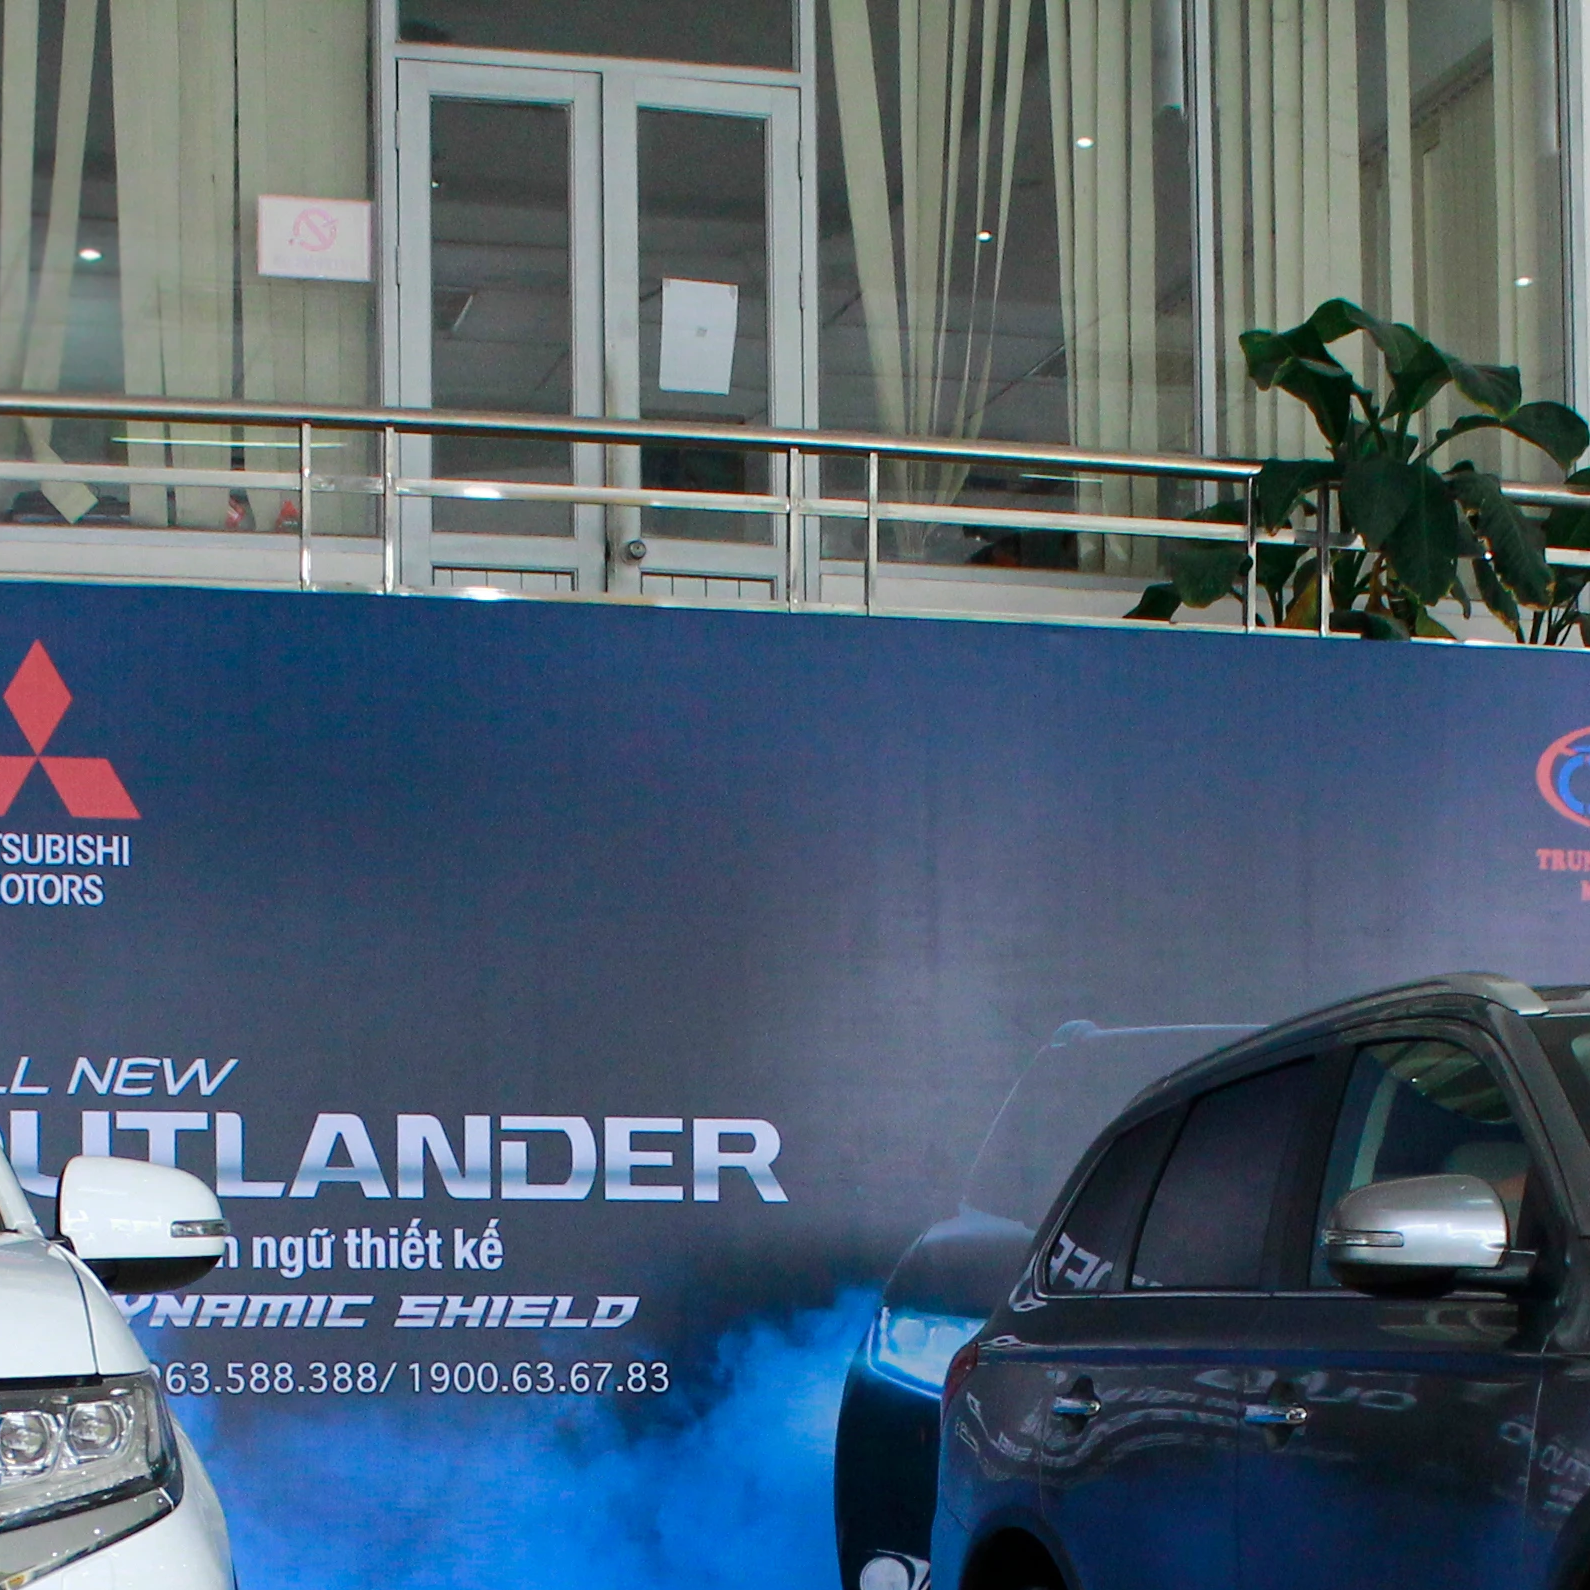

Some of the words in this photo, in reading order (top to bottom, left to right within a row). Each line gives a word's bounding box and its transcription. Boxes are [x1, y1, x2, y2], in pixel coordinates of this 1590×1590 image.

[66, 1056, 240, 1097] NEW
[252, 1227, 336, 1279] ngữ
[344, 1218, 444, 1269] thiết
[453, 1218, 504, 1270] kế
[112, 1294, 375, 1328] YNAMIC
[393, 1295, 641, 1329] SHIELD
[155, 1361, 398, 1395] 63.588.388/
[408, 1361, 671, 1394] 1900.63.67.83
